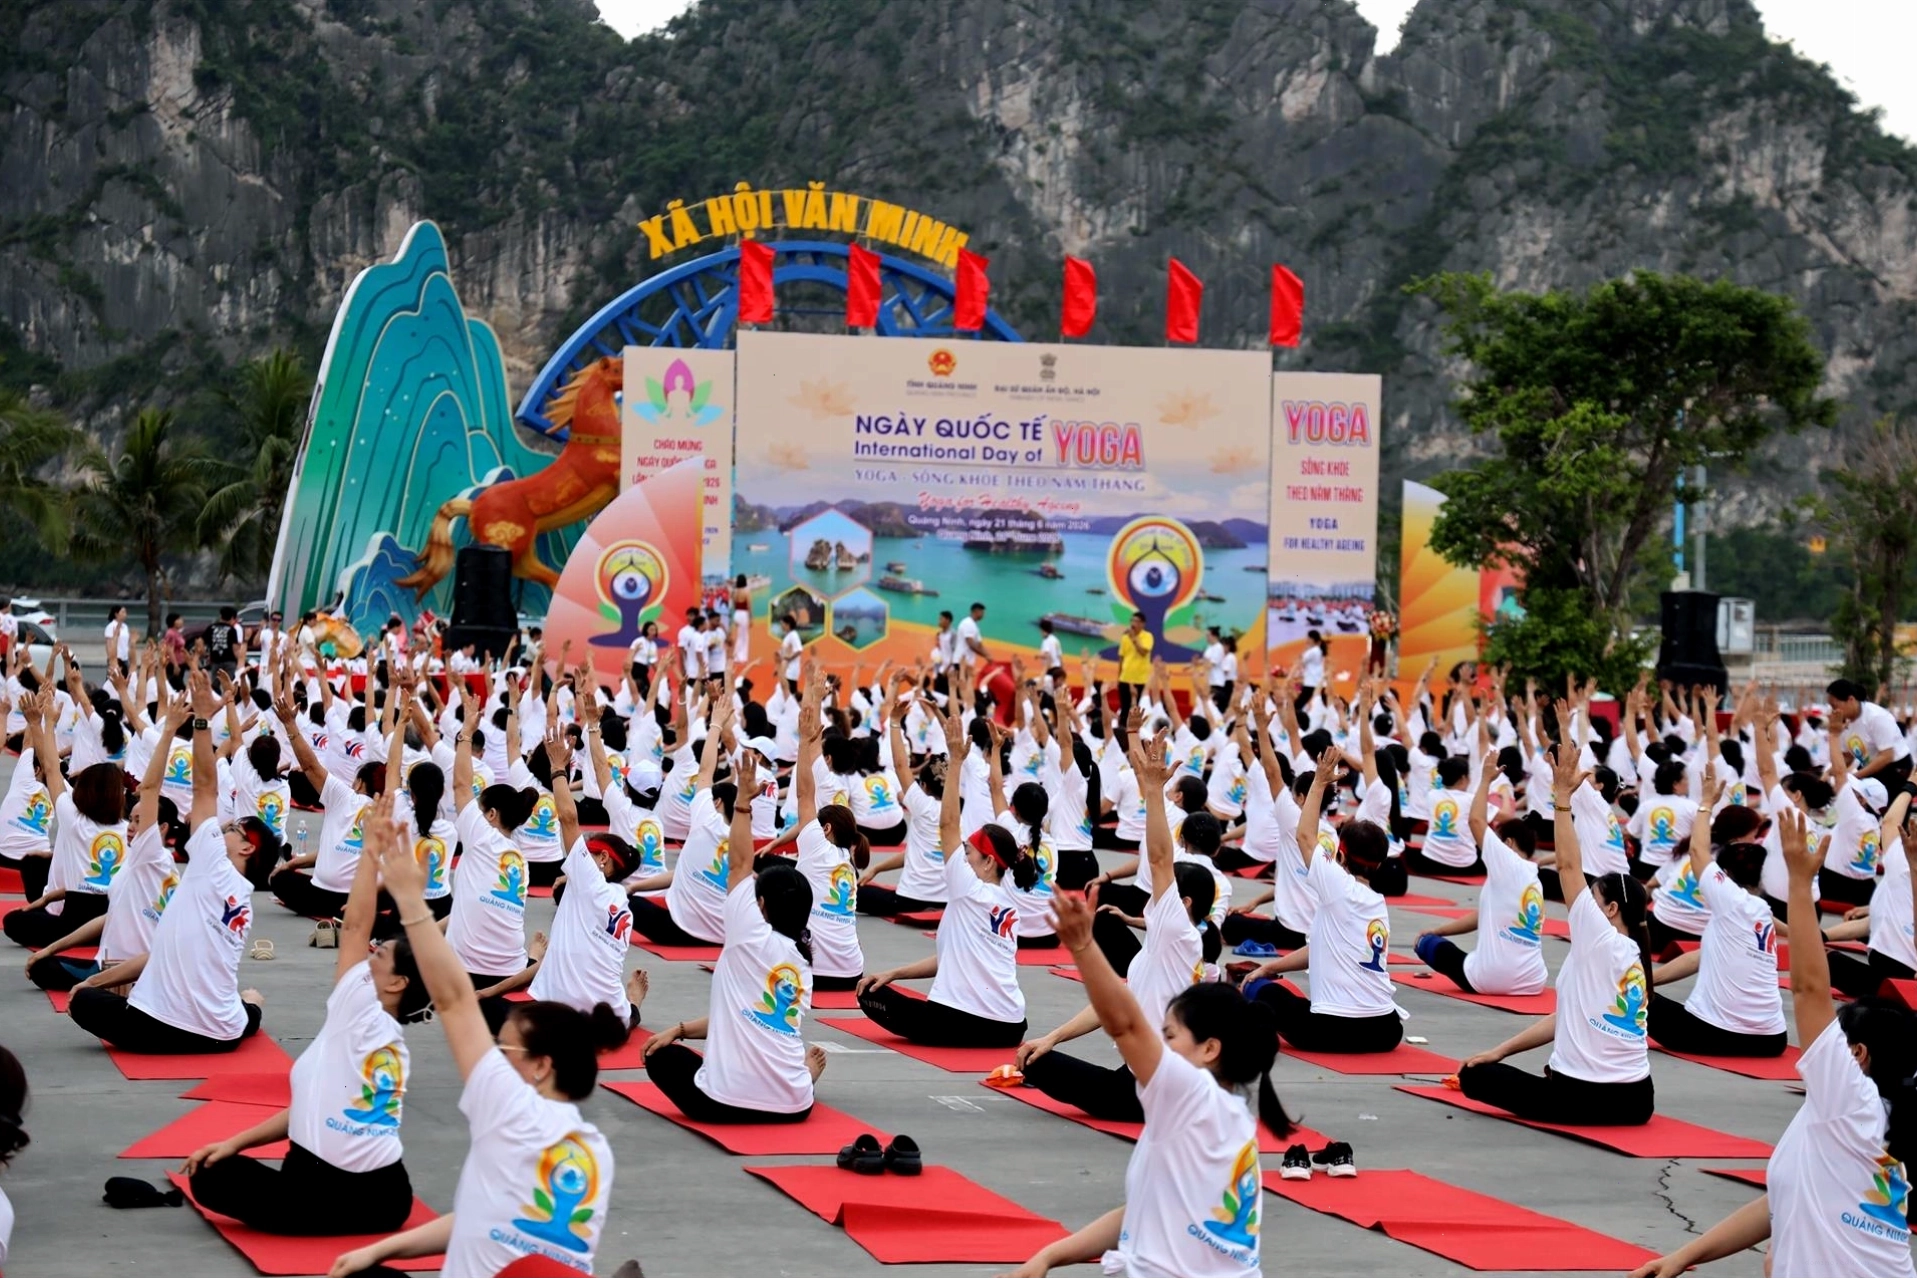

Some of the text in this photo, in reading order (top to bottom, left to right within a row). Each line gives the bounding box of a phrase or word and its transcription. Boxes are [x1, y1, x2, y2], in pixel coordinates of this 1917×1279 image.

[637, 181, 969, 268] XÃ HỘI VĂN MINH
[856, 411, 1047, 441] NGÀY QUỐC TẾ
[1282, 401, 1372, 447] YOGA
[855, 440, 1042, 465] International Day of
[1051, 420, 1144, 470] YOGA
[855, 469, 897, 482] YOGA
[1007, 475, 1047, 488] THEO
[918, 491, 954, 513] Yoga
[1310, 518, 1338, 530] YOGA
[1284, 537, 1365, 552] FOR HEALTHY AGEING
[1841, 1212, 1884, 1236] QUẢNG
